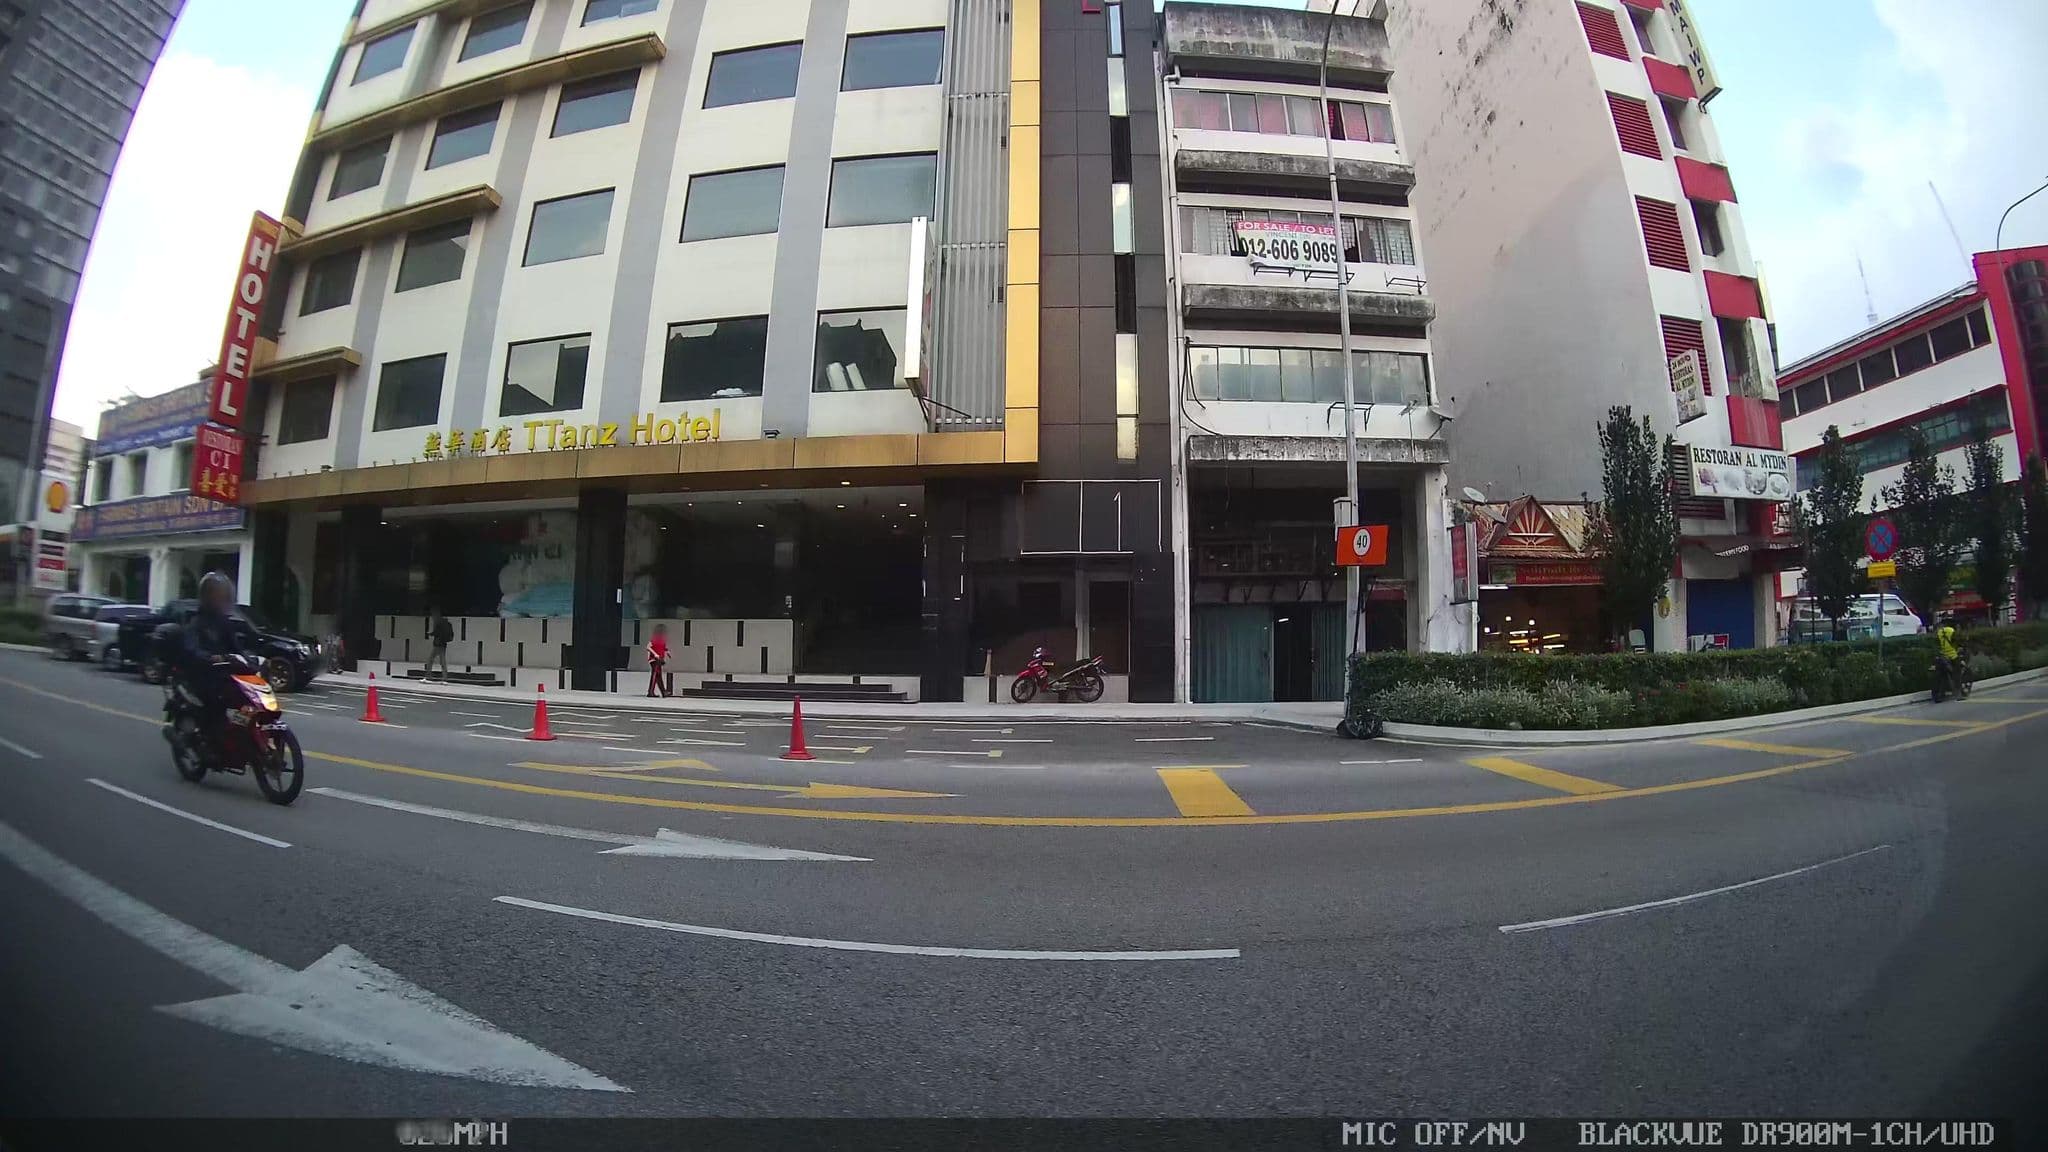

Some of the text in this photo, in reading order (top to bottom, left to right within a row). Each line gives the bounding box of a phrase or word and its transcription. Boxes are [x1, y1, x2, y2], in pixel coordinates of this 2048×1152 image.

[1238, 222, 1261, 231] FOR
[1265, 223, 1290, 232] SALE
[1318, 227, 1335, 235] LET
[1240, 237, 1338, 263] 012-606 9089
[219, 236, 273, 418] HOTEL
[523, 408, 722, 451] TTanz Hotel
[1693, 447, 1788, 470] RESTORAN AL MYDIN
[1356, 535, 1368, 548] 40
